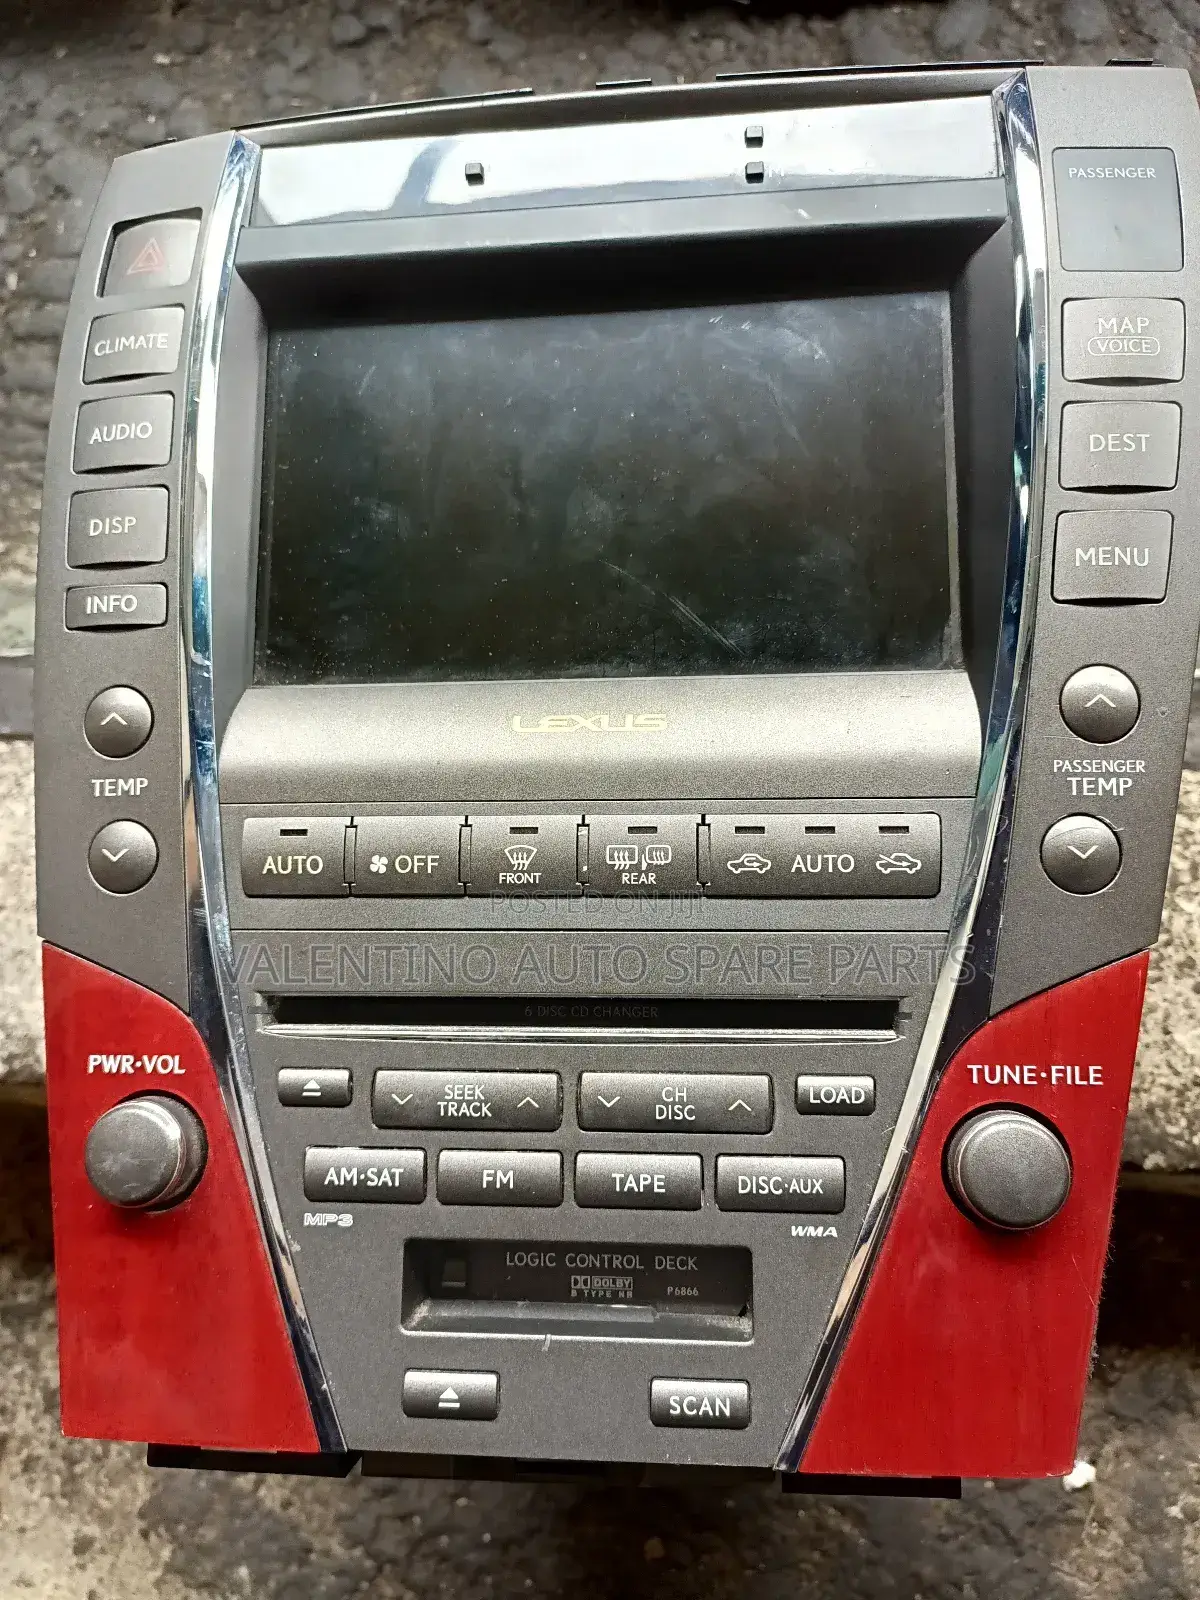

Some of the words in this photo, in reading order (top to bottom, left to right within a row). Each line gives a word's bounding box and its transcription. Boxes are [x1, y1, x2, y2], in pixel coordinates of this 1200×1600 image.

[1068, 166, 1156, 181] PASSENGER
[1097, 316, 1149, 334] MAP
[93, 331, 169, 356] CLIMATE
[1097, 338, 1151, 354] VOICE
[88, 421, 153, 442] AUDIO
[1089, 432, 1150, 452] DEST
[88, 515, 136, 536] DISP
[1075, 546, 1150, 567] MENU
[86, 594, 138, 614] INFO
[512, 714, 668, 732] LEXUS
[1053, 759, 1146, 774] PASSENGER
[92, 778, 149, 798] TEMP
[1068, 777, 1134, 796] TEMP
[262, 856, 323, 875] AUTO
[394, 855, 440, 874] OFF
[791, 854, 855, 873] AUTO
[498, 872, 541, 884] FRONT
[622, 872, 656, 885] REAR
[524, 1006, 532, 1017] 6
[537, 1006, 567, 1017] DISC
[571, 1006, 589, 1017] CD
[593, 1006, 658, 1018] CHANGER
[444, 1084, 485, 1100] SEEK
[662, 1087, 687, 1103] CH
[808, 1086, 866, 1105] LOAD
[437, 1100, 492, 1118] TRACK
[655, 1104, 696, 1121] DISC
[482, 1170, 514, 1189] FM
[611, 1174, 666, 1193] TAPE
[304, 1213, 353, 1227] MP3
[791, 1225, 838, 1238] WMA
[506, 1252, 556, 1267] LOGIC
[565, 1253, 644, 1269] CONTROL
[655, 1255, 698, 1270] DECK
[594, 1278, 631, 1288] DOLBY
[667, 1287, 699, 1296] P6866
[584, 1290, 612, 1298] TYPE
[669, 1396, 731, 1417] SCAN
